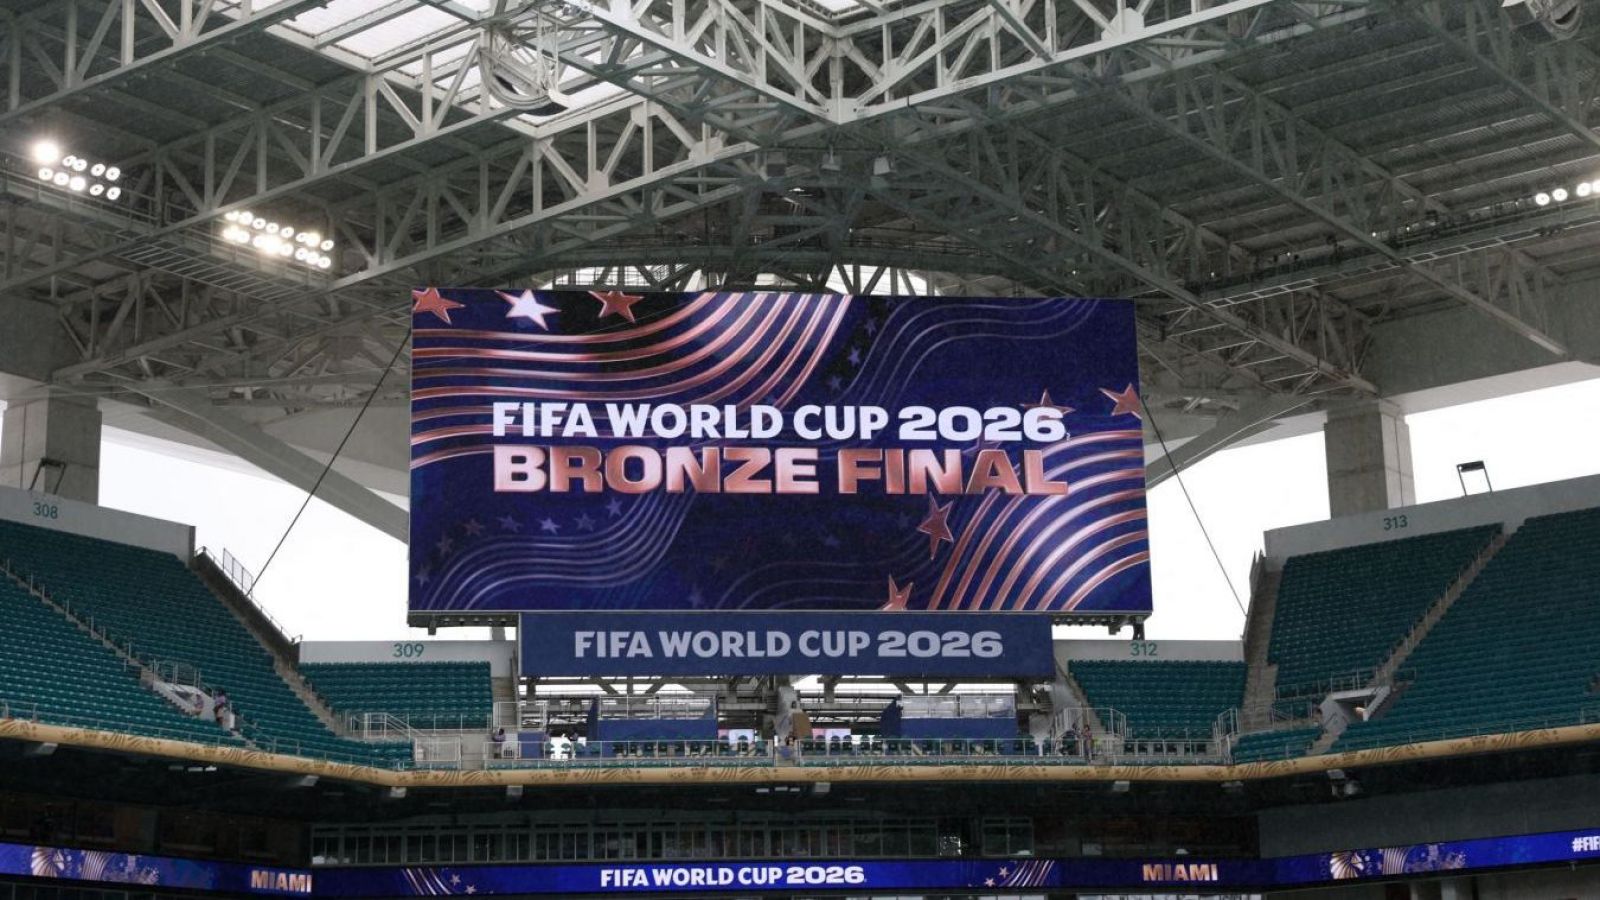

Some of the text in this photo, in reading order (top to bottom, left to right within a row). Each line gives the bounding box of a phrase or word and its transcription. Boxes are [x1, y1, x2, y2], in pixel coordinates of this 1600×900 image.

[493, 402, 1066, 442] FIFA WORLD CUP 2026
[493, 445, 1069, 495] BRONZE FINAL
[33, 502, 58, 519] 308
[1383, 515, 1409, 531] 313
[393, 643, 425, 658] 309
[574, 630, 1003, 658] FIFA WORLD CUP 2026
[1130, 641, 1158, 657] 312
[251, 869, 312, 893] MIAMI
[600, 866, 865, 887] FIFA WORLD CUP 2026
[1143, 863, 1218, 881] MIAMI
